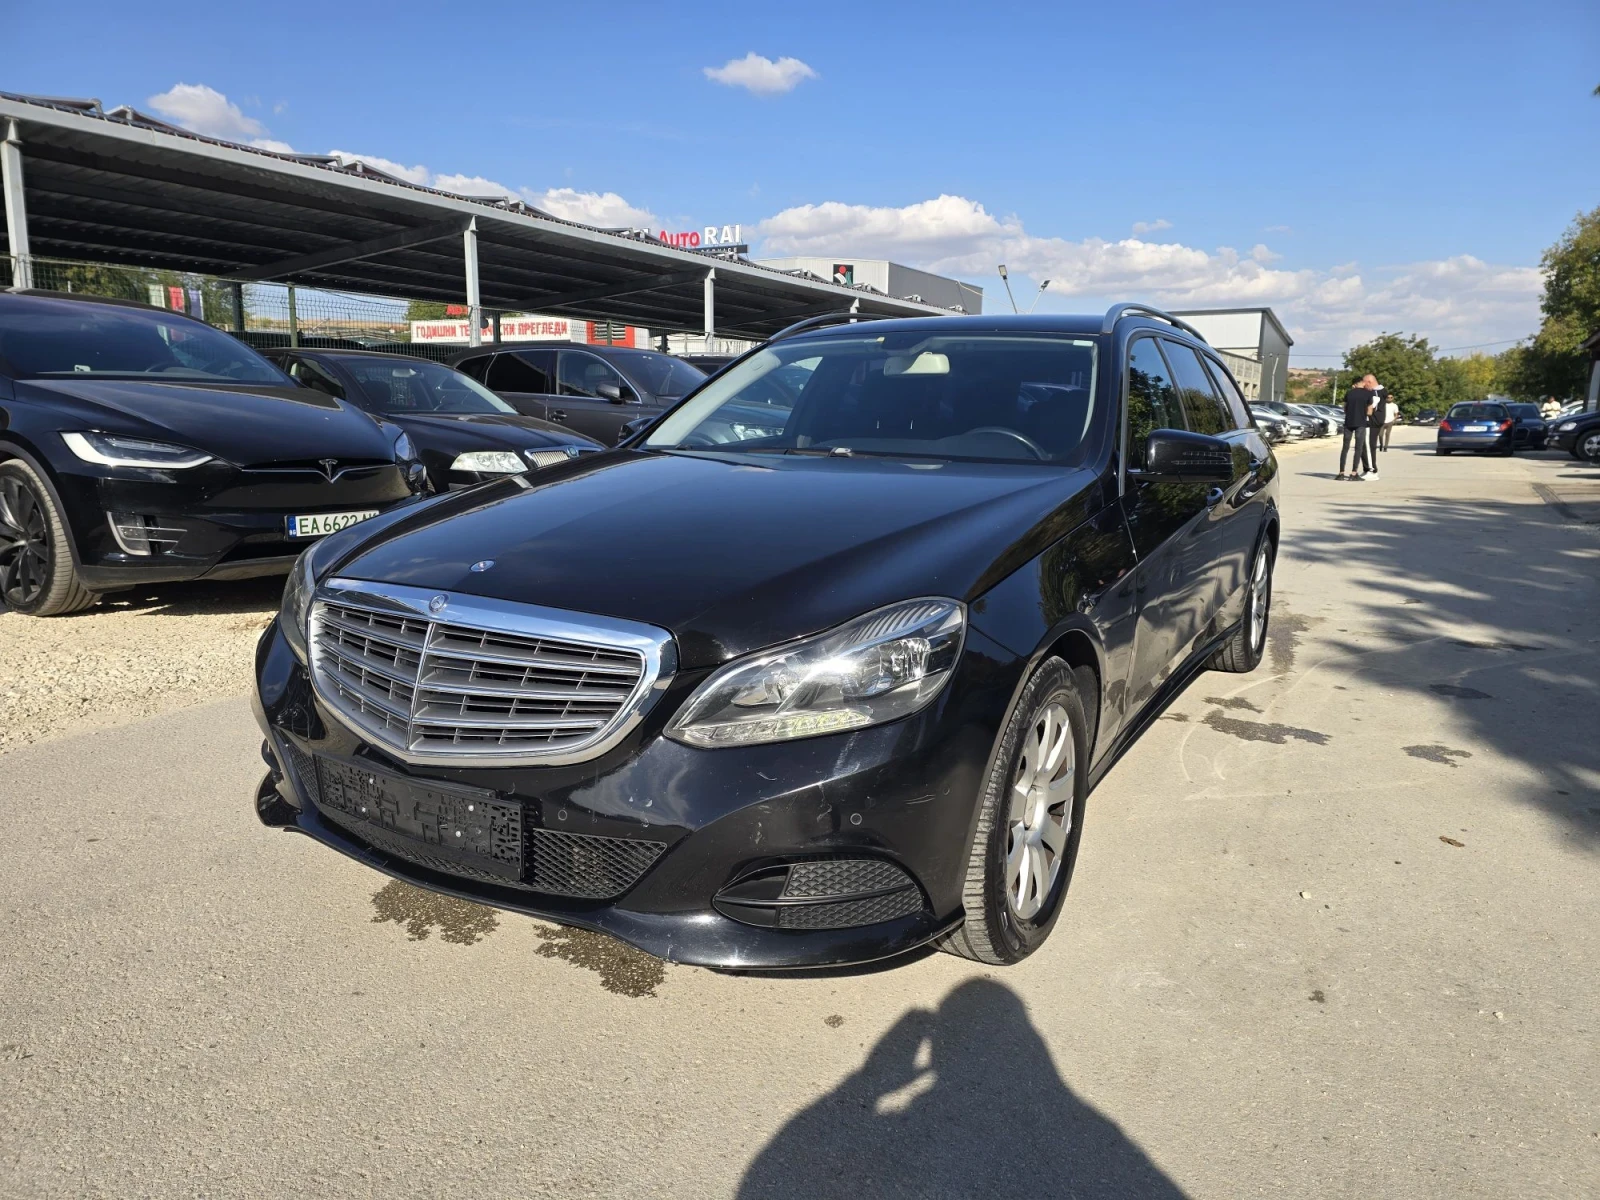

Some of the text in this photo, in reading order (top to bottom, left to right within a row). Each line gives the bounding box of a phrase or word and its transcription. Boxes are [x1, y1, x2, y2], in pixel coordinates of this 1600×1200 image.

[659, 224, 742, 248] AUTO RAI
[416, 324, 457, 339] ГОДИШНИ
[518, 321, 568, 336] ПРЕГЛЕДИ
[299, 518, 320, 534] EA
